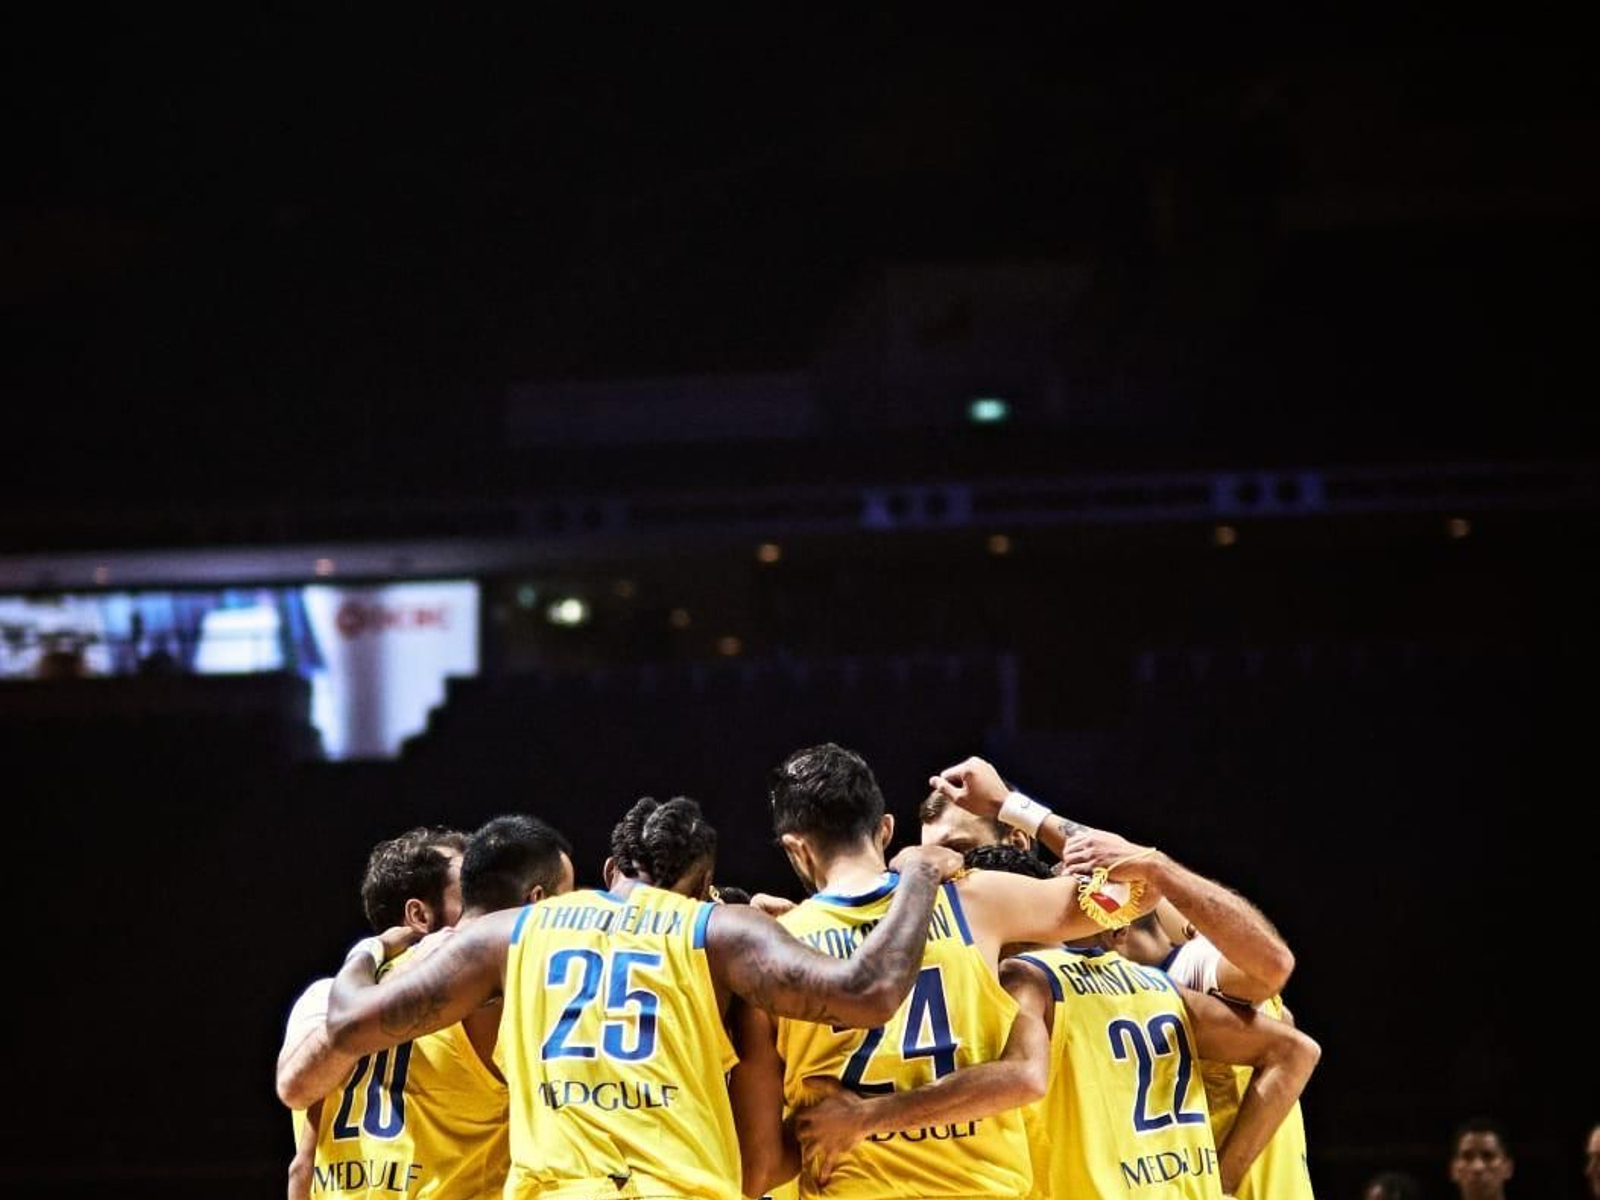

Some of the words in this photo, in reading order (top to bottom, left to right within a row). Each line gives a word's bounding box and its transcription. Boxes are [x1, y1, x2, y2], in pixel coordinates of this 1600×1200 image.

[541, 948, 662, 1062] 25
[830, 967, 957, 1094] 24
[1107, 1013, 1207, 1135] 22
[313, 1159, 423, 1194] MEDULF
[1119, 1146, 1217, 1190] MEDUF
